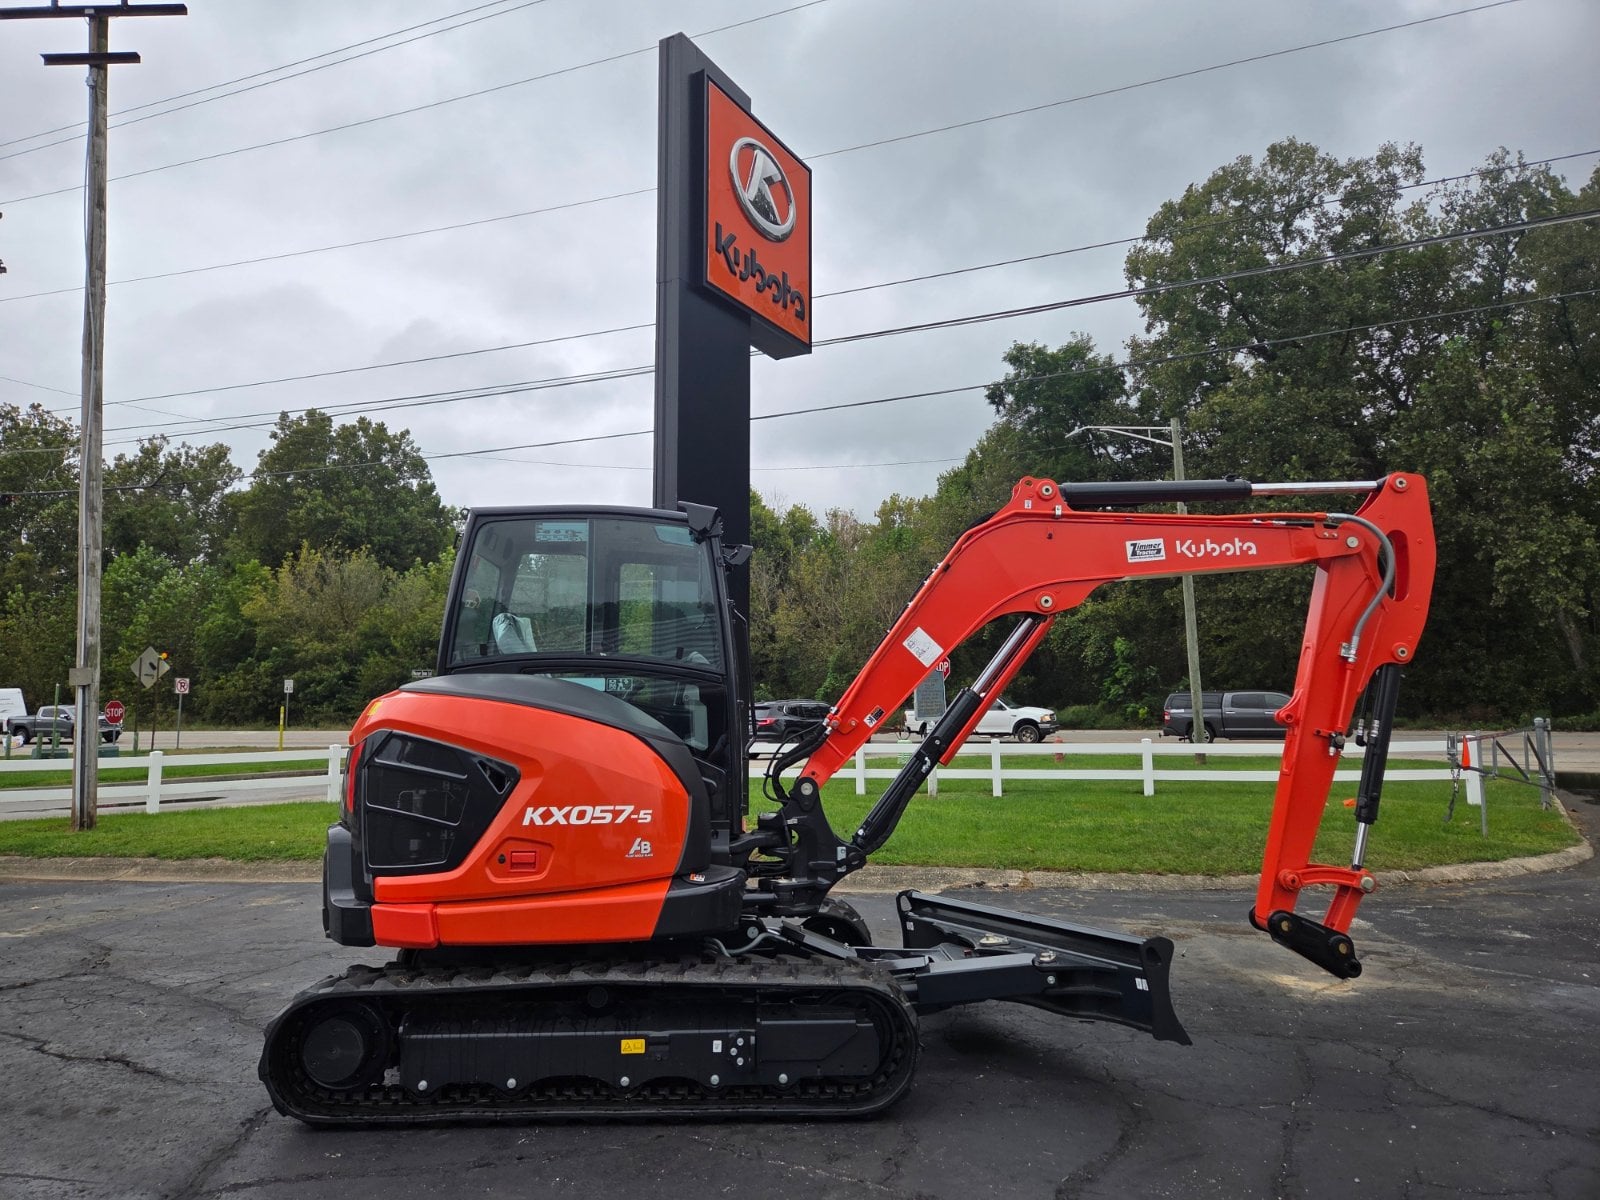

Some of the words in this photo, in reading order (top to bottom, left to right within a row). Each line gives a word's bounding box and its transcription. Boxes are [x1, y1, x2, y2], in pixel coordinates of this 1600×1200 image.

[715, 222, 805, 321] Kubota
[1130, 542, 1161, 556] Zimmer
[1175, 538, 1257, 557] Kubota
[106, 708, 123, 717] STOP
[522, 805, 653, 825] KX057-5
